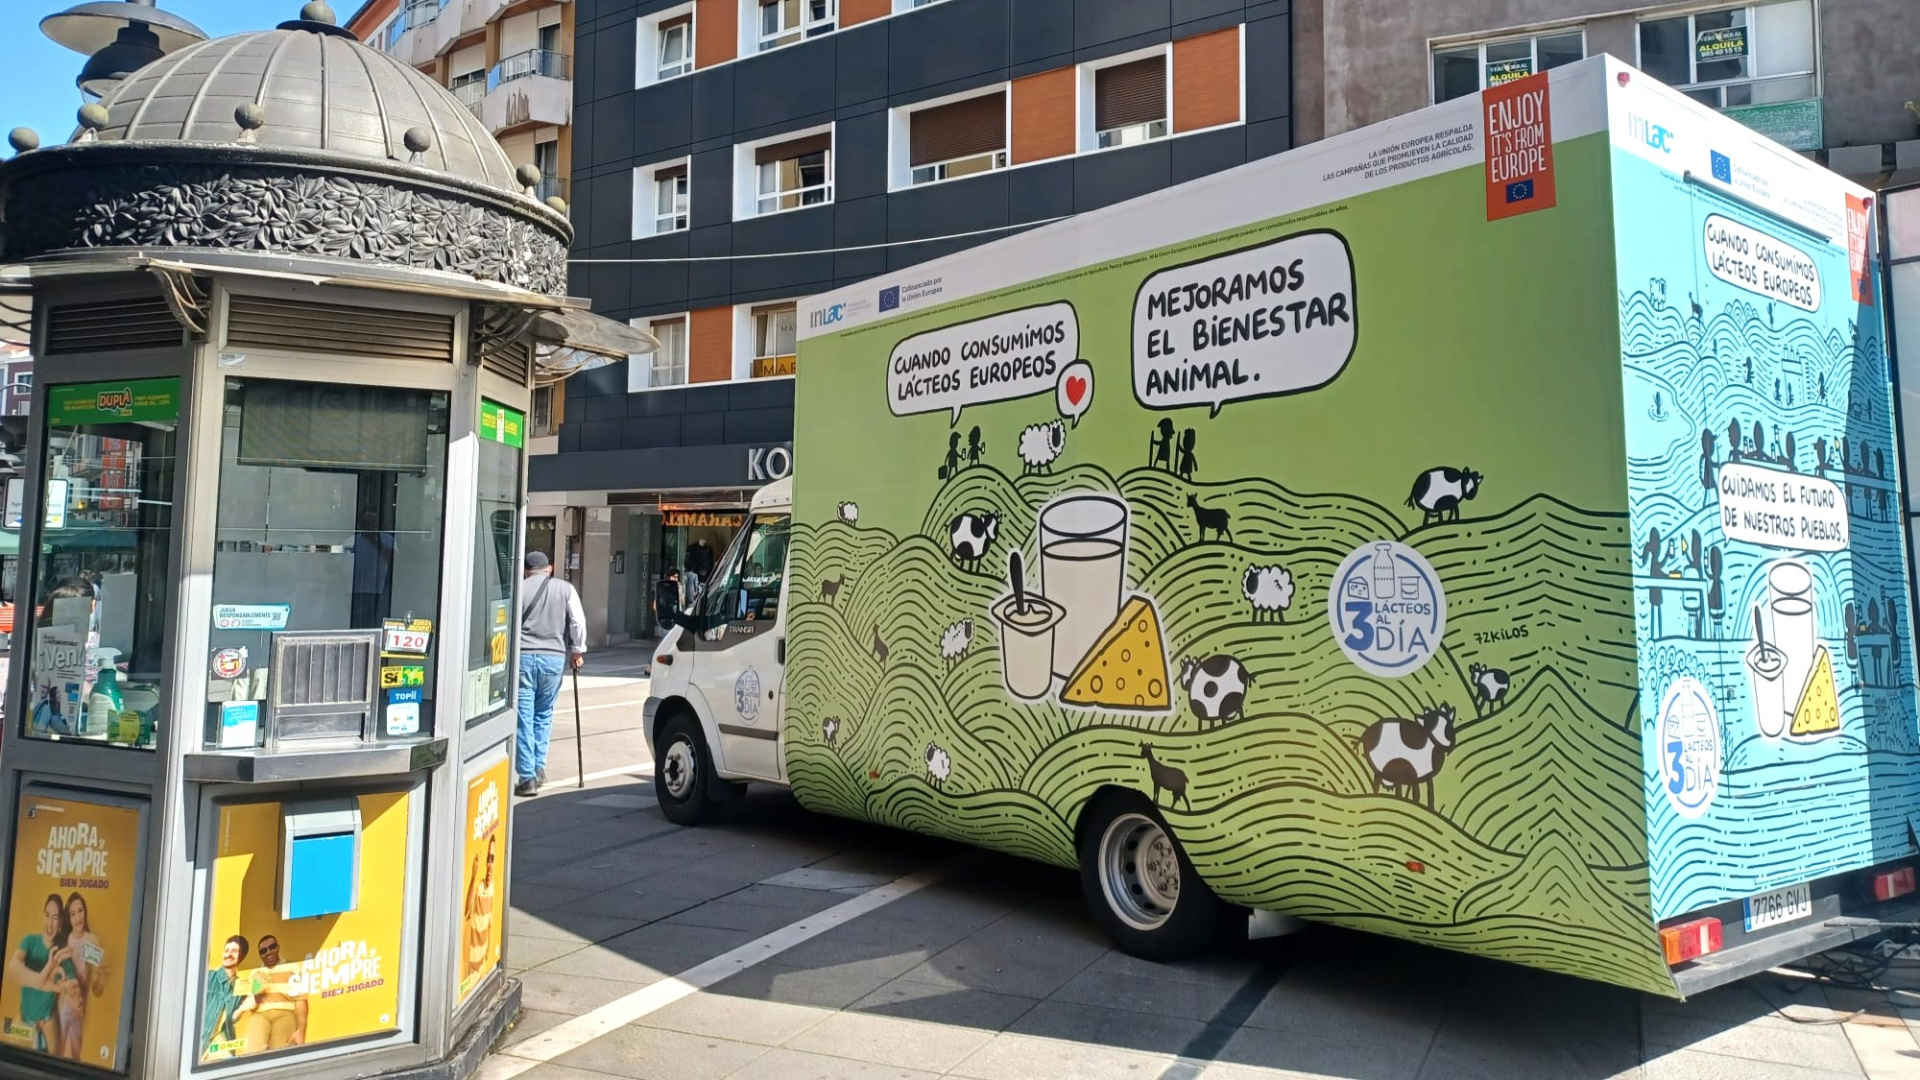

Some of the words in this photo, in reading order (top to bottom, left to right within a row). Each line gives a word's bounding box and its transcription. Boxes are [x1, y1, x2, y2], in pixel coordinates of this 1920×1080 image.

[1699, 40, 1744, 52] ALQUILA
[1490, 70, 1530, 82] ALQUILA
[1489, 89, 1544, 136] ENJOY
[1368, 151, 1378, 159] LA
[1378, 143, 1400, 156] UNIÓN
[1401, 134, 1434, 150] EUROPEA
[1435, 123, 1474, 140] RESPALDA
[1491, 131, 1512, 157] IT'S
[1515, 122, 1544, 151] FROM
[1323, 172, 1335, 182] LAS
[1336, 161, 1371, 178] CAMPAÑAS
[1372, 158, 1386, 168] QUE
[1387, 147, 1430, 163] PROMUEVEN
[1431, 142, 1441, 151] LA
[1442, 133, 1474, 147] CALIDAD
[1364, 170, 1374, 179] DE
[1375, 166, 1388, 176] LOS
[1389, 155, 1430, 172] PRODUCTOS
[1431, 143, 1474, 161] AGRÍCOLAS.
[1491, 145, 1547, 184] EUROPE
[1707, 223, 1749, 256] CUANDO
[922, 286, 943, 299] Europea
[933, 276, 943, 287] por
[1148, 258, 1305, 320] MEJORAMOS
[1712, 249, 1757, 286] LÁCTEOS
[1763, 270, 1812, 306] EUROPEOS
[1148, 329, 1175, 358] EL
[894, 347, 951, 375] CUANDO
[898, 368, 961, 401] LÁCTEOS
[970, 350, 1057, 389] EUROPEOS
[99, 389, 131, 409] DUPLA
[748, 447, 793, 481] KO
[1783, 483, 1796, 503] EL
[1801, 486, 1835, 509] FUTURO
[1724, 505, 1737, 528] DE
[1744, 510, 1796, 538] NUESTROS
[1801, 516, 1846, 543] PUEBLOS.
[1375, 600, 1431, 615] LÁCTEOS
[393, 635, 424, 648] 120
[1344, 602, 1374, 651] 3
[1376, 615, 1391, 625] AL
[1376, 619, 1429, 653] DÍA
[384, 672, 399, 685] Sí
[736, 690, 745, 713] 3
[1667, 741, 1684, 794] 3
[1685, 757, 1714, 792] DÍA
[48, 822, 97, 849] AHORA
[37, 846, 108, 878] SIEMPRE
[60, 878, 77, 888] BIEN
[79, 879, 109, 889] JUGADO
[1753, 893, 1783, 924] 7766
[1786, 887, 1807, 916] GVJ
[301, 940, 368, 972] AHORA
[288, 956, 381, 997] SIEMPRE
[322, 988, 344, 999] BIEN
[347, 978, 384, 994] JUGADO
[11, 1026, 30, 1038] ONCE
[220, 1040, 245, 1049] ONCE
